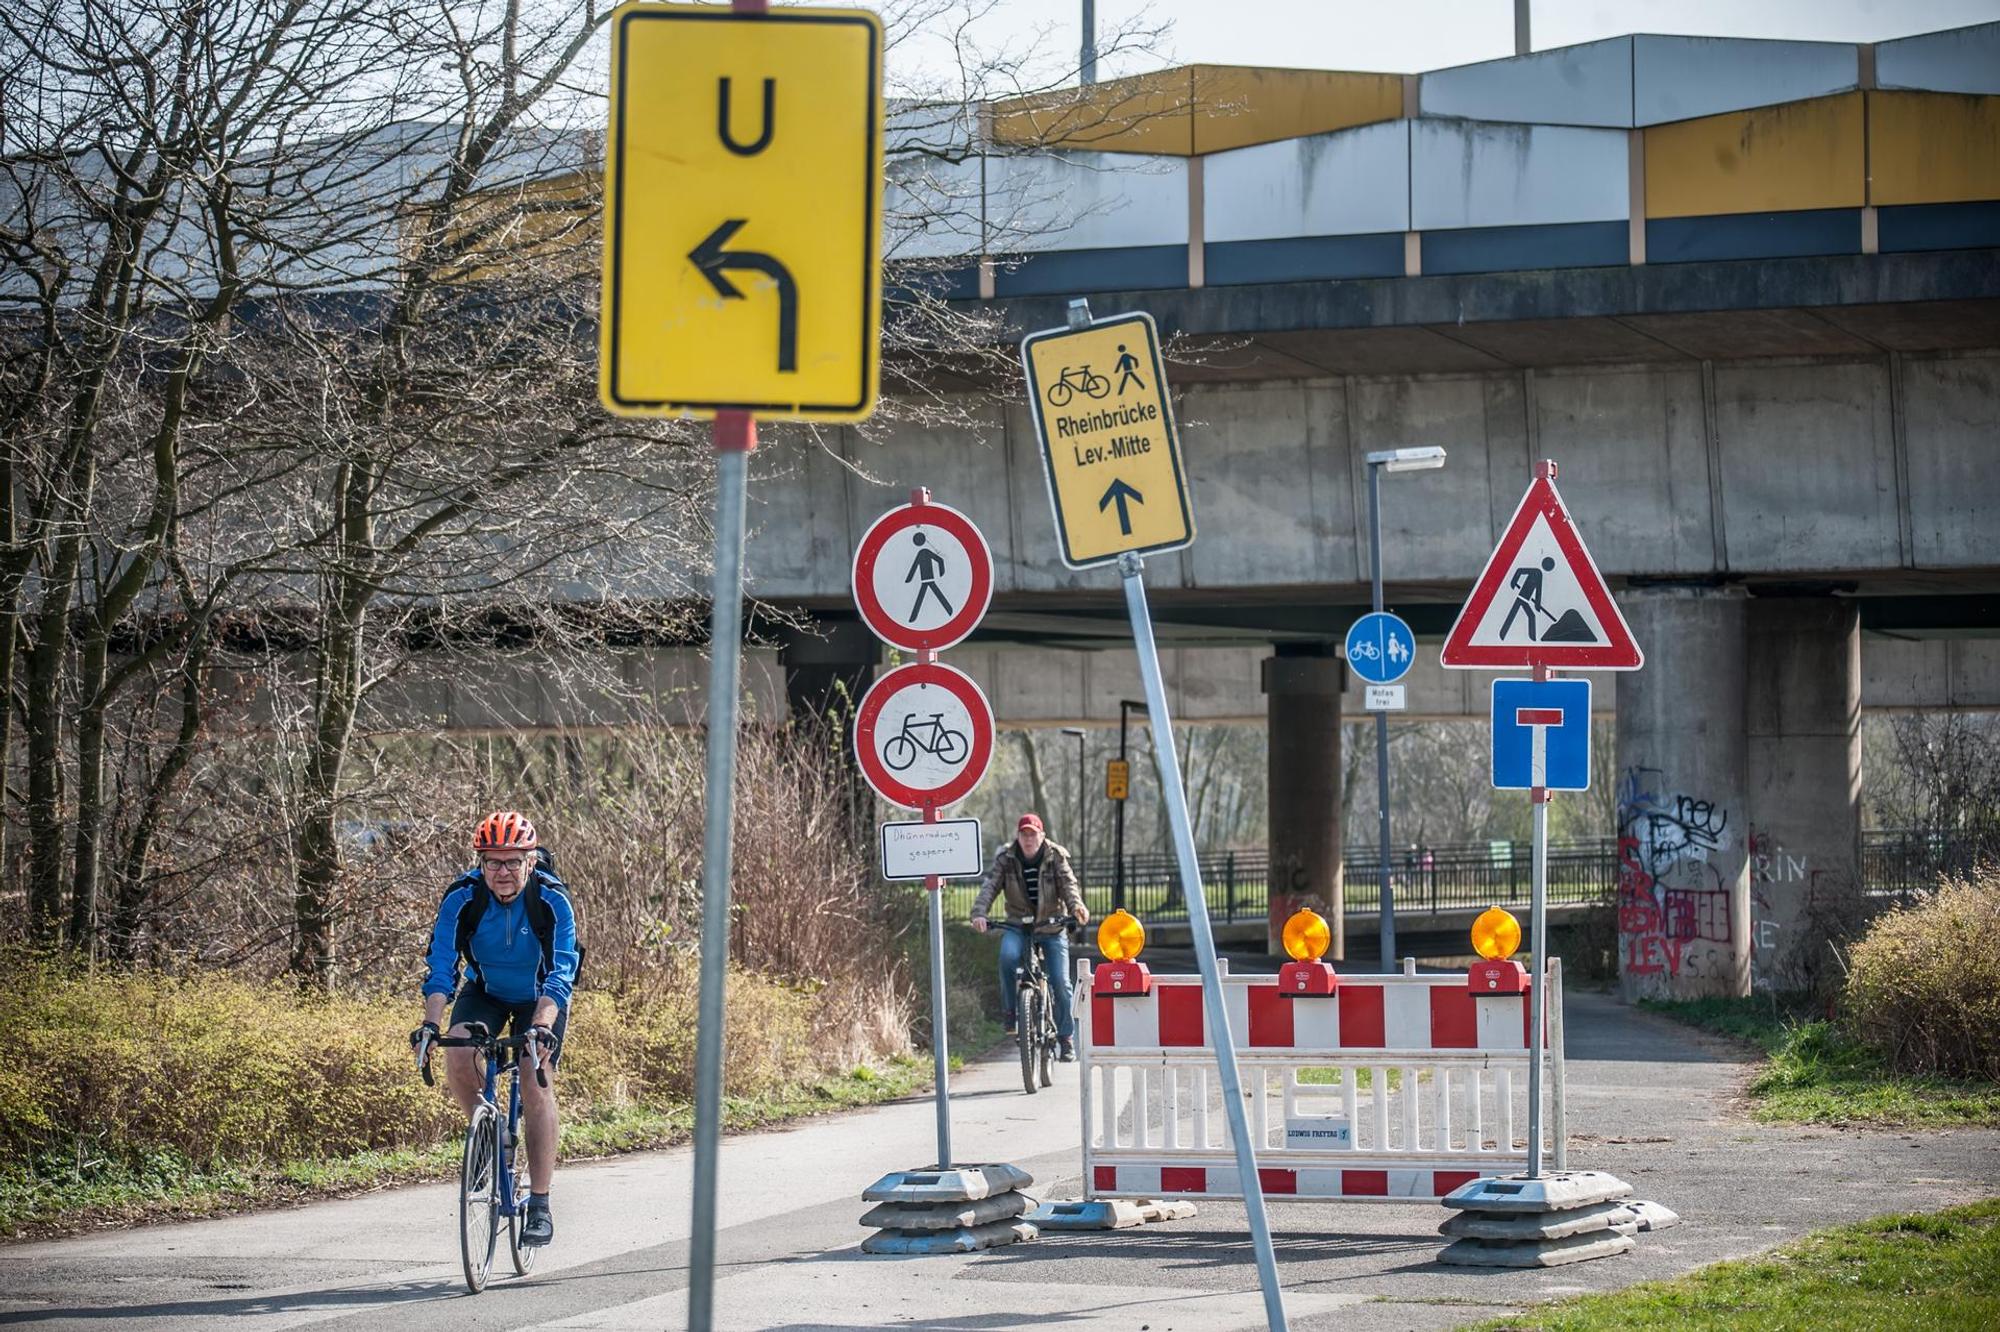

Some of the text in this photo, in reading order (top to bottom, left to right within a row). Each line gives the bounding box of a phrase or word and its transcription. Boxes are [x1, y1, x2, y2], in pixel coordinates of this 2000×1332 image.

[718, 76, 776, 158] U
[1056, 401, 1158, 438] Rheinbrücke
[1073, 435, 1152, 467] Lev.-Mitte
[908, 847, 954, 862] gesperrt
